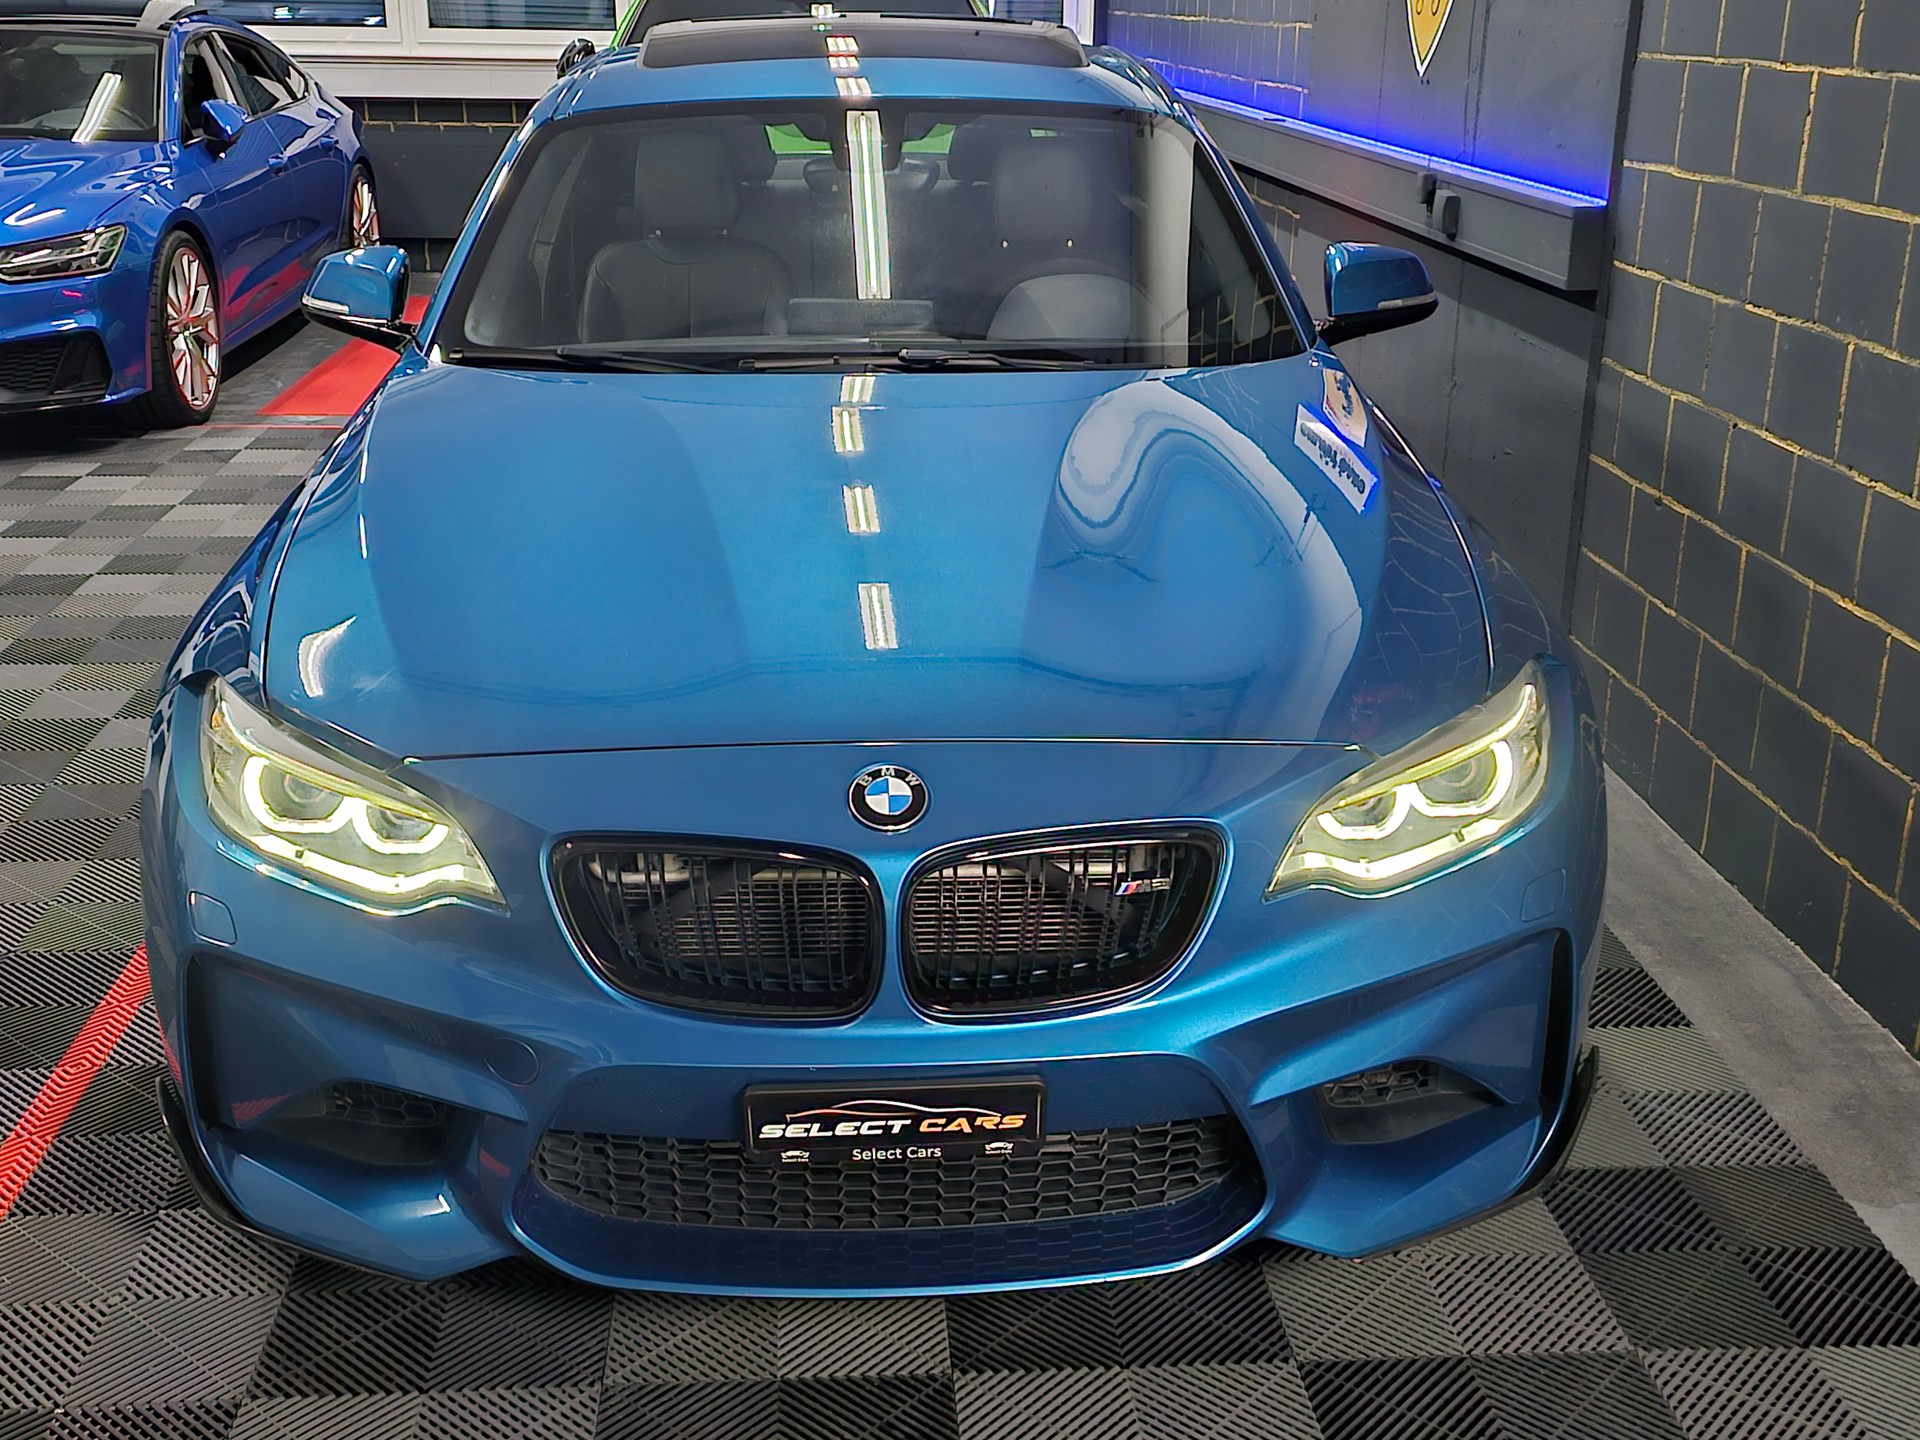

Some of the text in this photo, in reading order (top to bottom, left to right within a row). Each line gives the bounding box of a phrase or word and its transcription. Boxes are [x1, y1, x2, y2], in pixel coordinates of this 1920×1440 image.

[858, 767, 920, 787] BMW
[759, 1114, 1027, 1138] SELECT CARS
[852, 1147, 942, 1160] Select Cars
